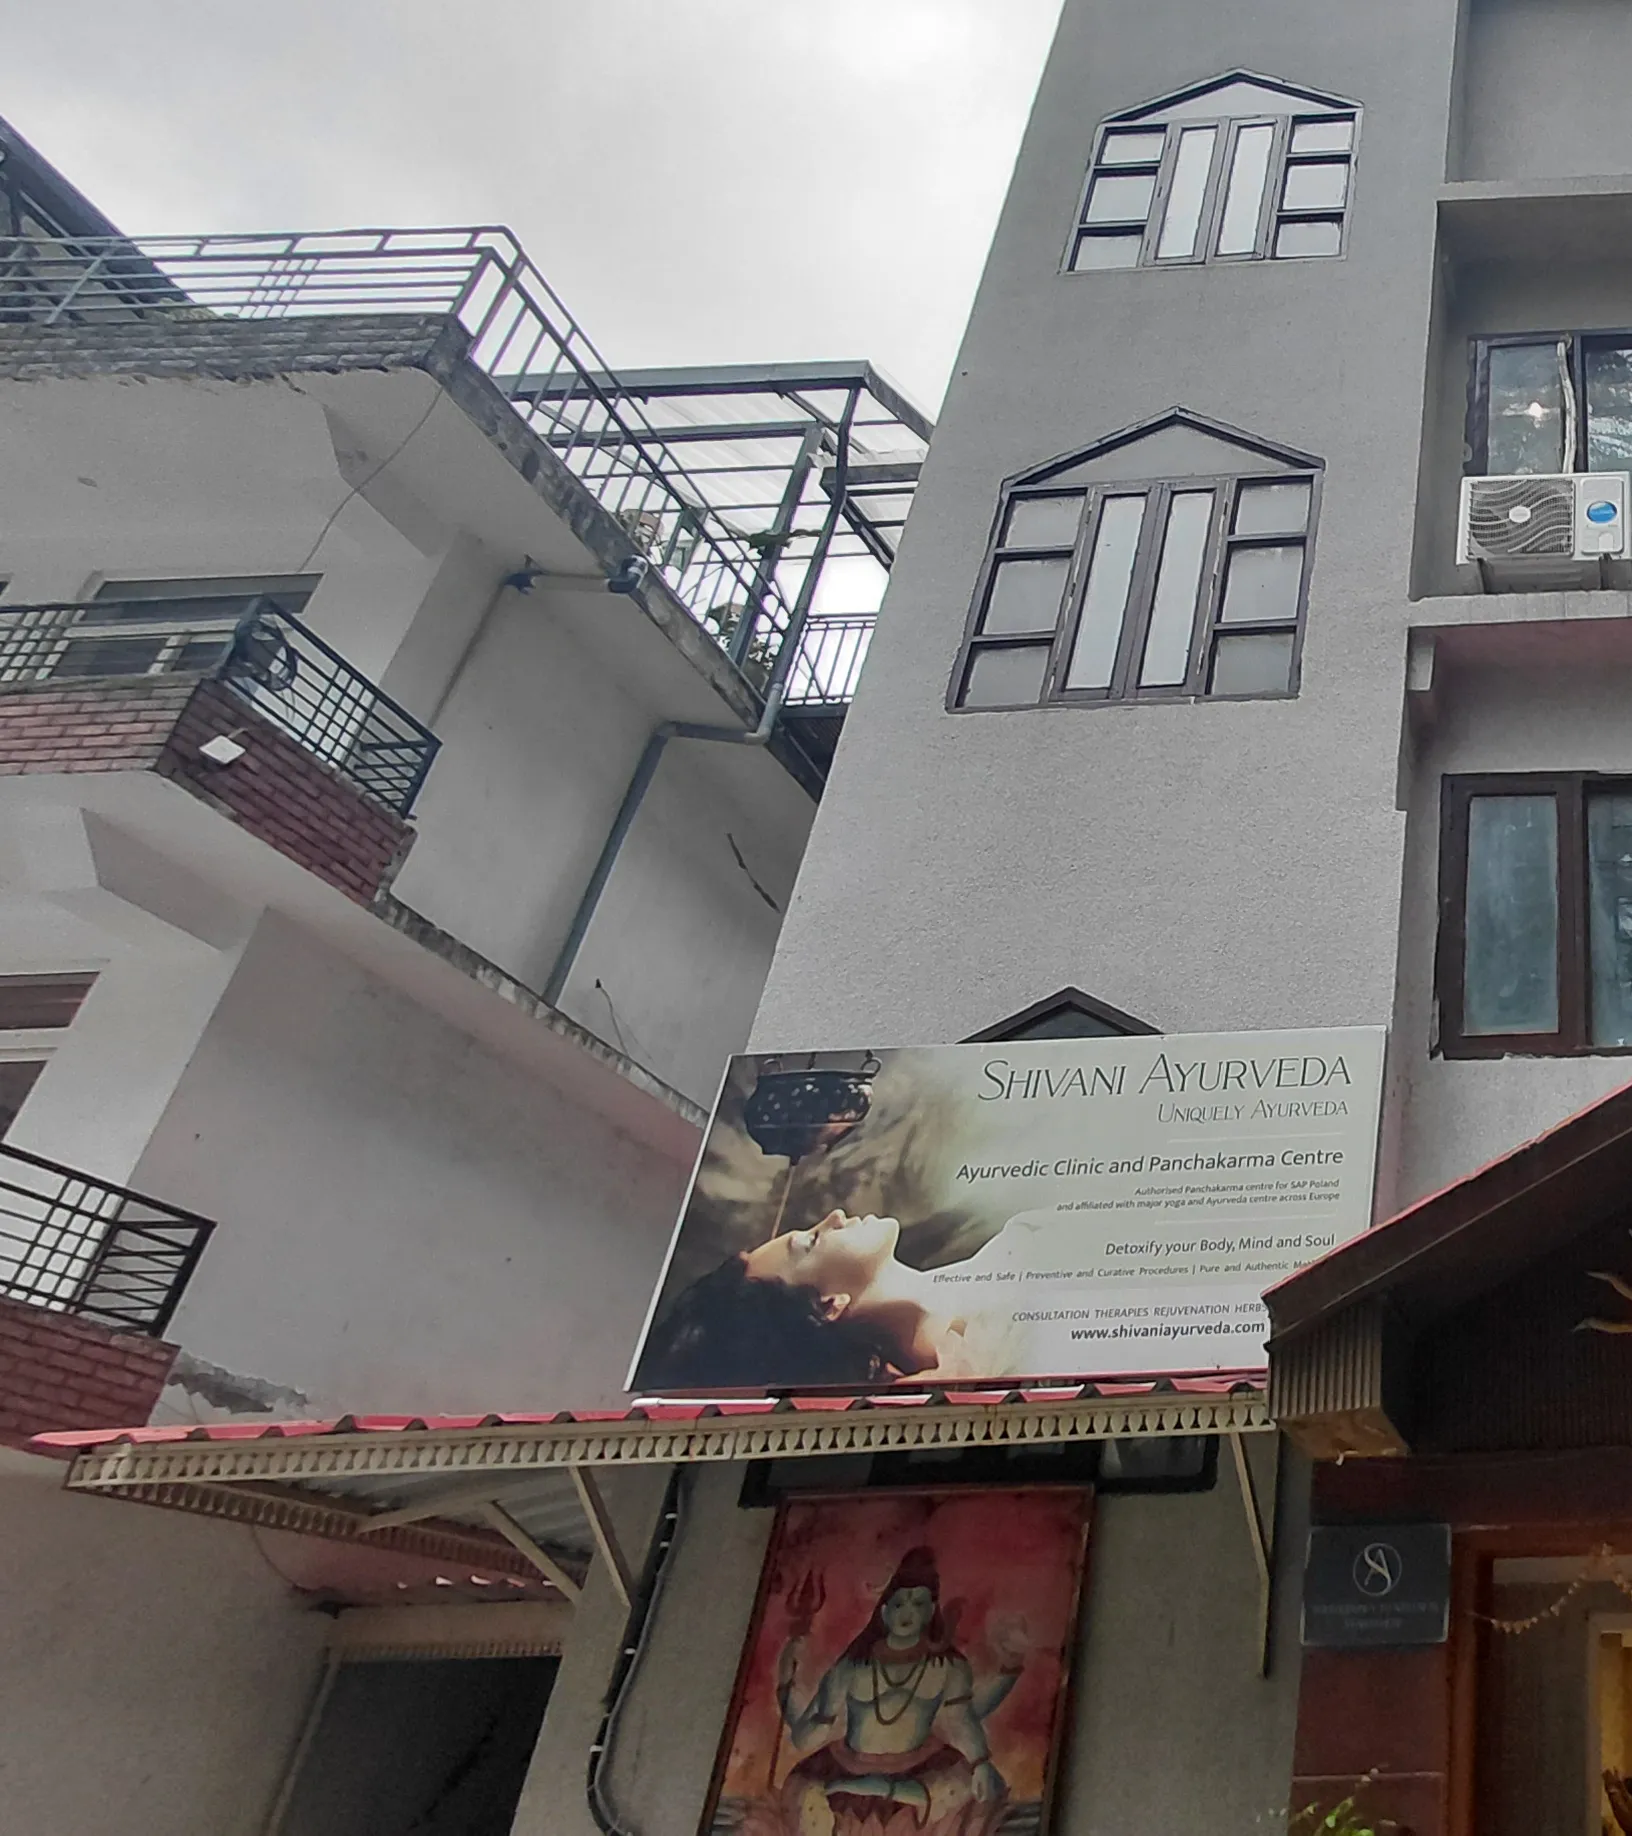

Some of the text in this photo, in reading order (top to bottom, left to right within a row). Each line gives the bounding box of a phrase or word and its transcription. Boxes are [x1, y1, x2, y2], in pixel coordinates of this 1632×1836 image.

[978, 1053, 1351, 1101] SHIVANI AYURVEDA
[1158, 1099, 1349, 1124] UNIQUELY AYURVEDA
[956, 1149, 1344, 1184] Ayurvedic Clinic and Panchakarma Centre
[1135, 1179, 1340, 1196] Authorised Panchakarma centre for SAP Poland
[1056, 1191, 1341, 1211] and affiliated with major yoga and Ayurveda centre across Europe
[1105, 1233, 1335, 1257] Detoxify your Body, Mind and Soul
[933, 1272, 971, 1284] Effective
[974, 1272, 992, 1282] and
[996, 1271, 1016, 1282] Safe
[1026, 1269, 1073, 1280] Preventive
[1076, 1268, 1094, 1279] and
[1097, 1267, 1136, 1277] Curative
[1138, 1264, 1189, 1276] Procedures
[1199, 1263, 1220, 1274] Pure
[1224, 1261, 1242, 1273] and
[1244, 1261, 1289, 1273] Authentic
[1011, 1309, 1090, 1322] CONSULTATION
[1094, 1307, 1149, 1319] THERAPIES
[1153, 1303, 1230, 1318] REJUVENATION
[1070, 1320, 1265, 1341] www.shivaniayurveda.com
